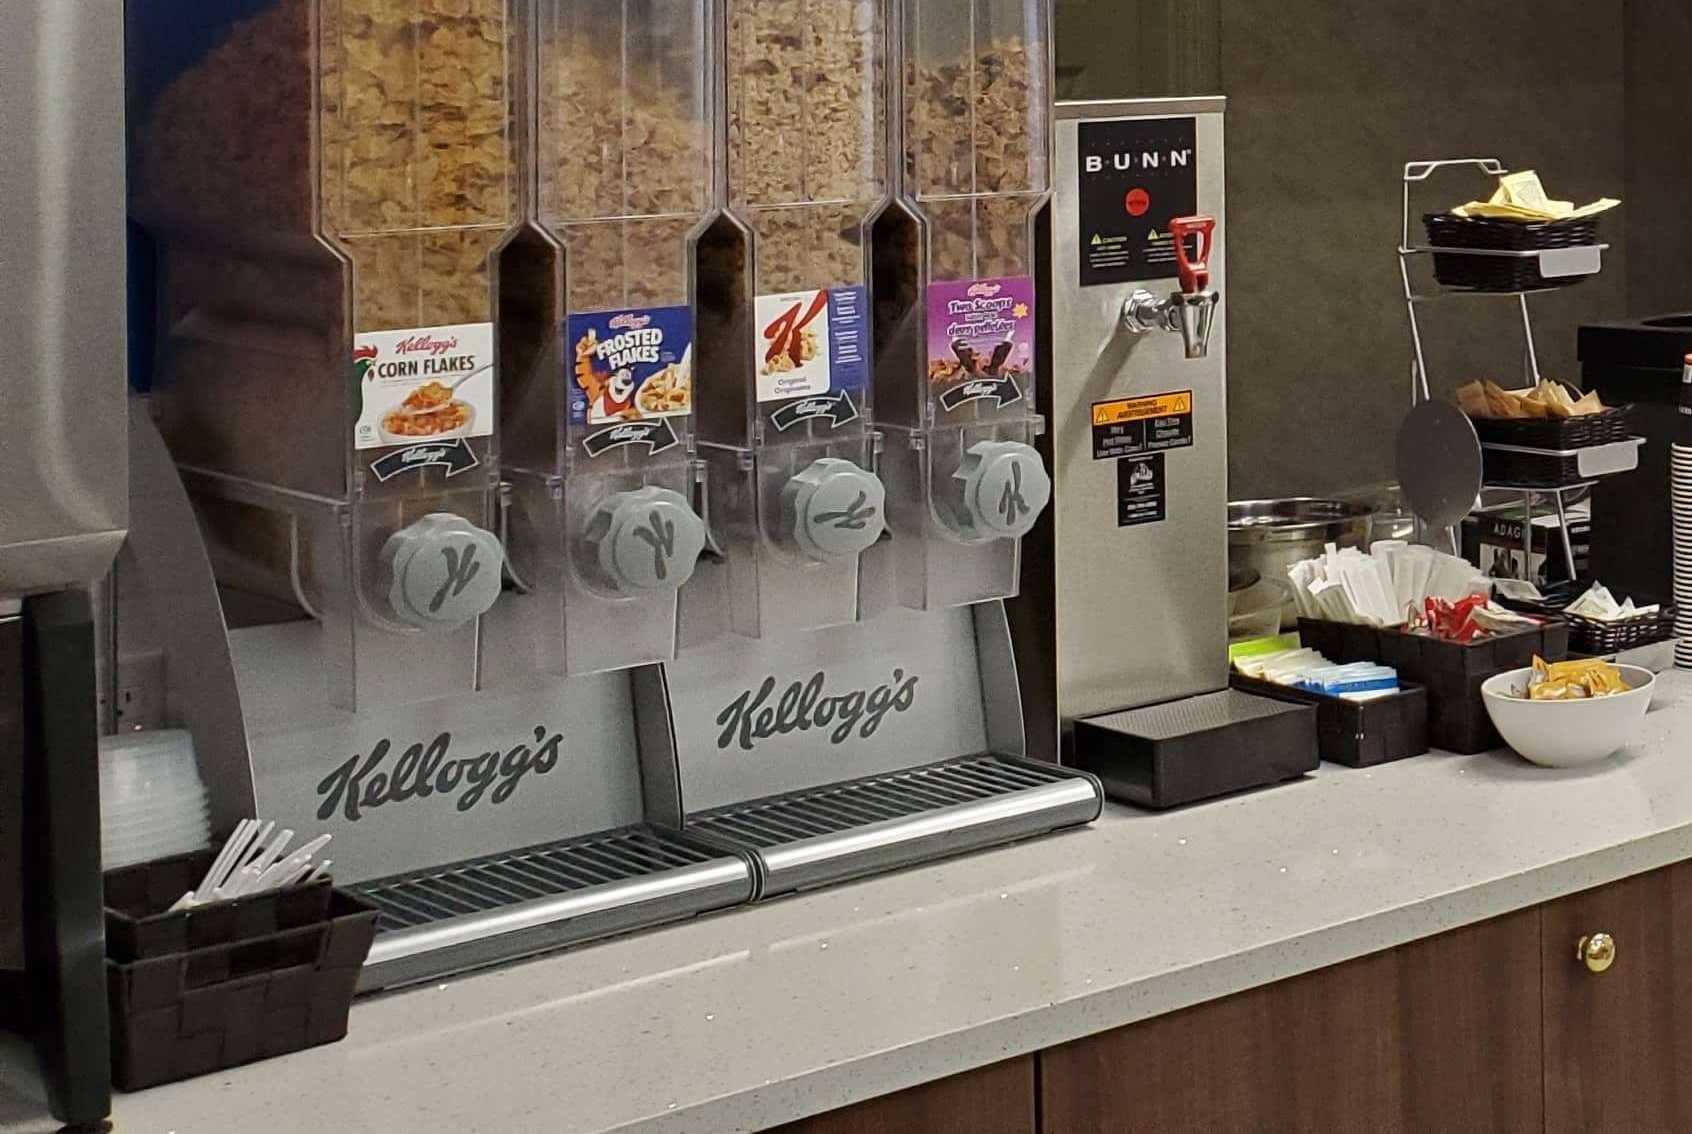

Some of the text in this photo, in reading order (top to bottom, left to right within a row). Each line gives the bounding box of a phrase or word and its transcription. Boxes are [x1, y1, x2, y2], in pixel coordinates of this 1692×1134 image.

[395, 335, 458, 355] Kellogg's
[596, 328, 663, 360] FROSTED
[378, 355, 475, 378] CORN FLAKES
[608, 346, 660, 370] FLAKES
[1493, 523, 1523, 539] ADAG
[715, 668, 919, 750] Kellogg's
[316, 724, 564, 822] Kellogg's
